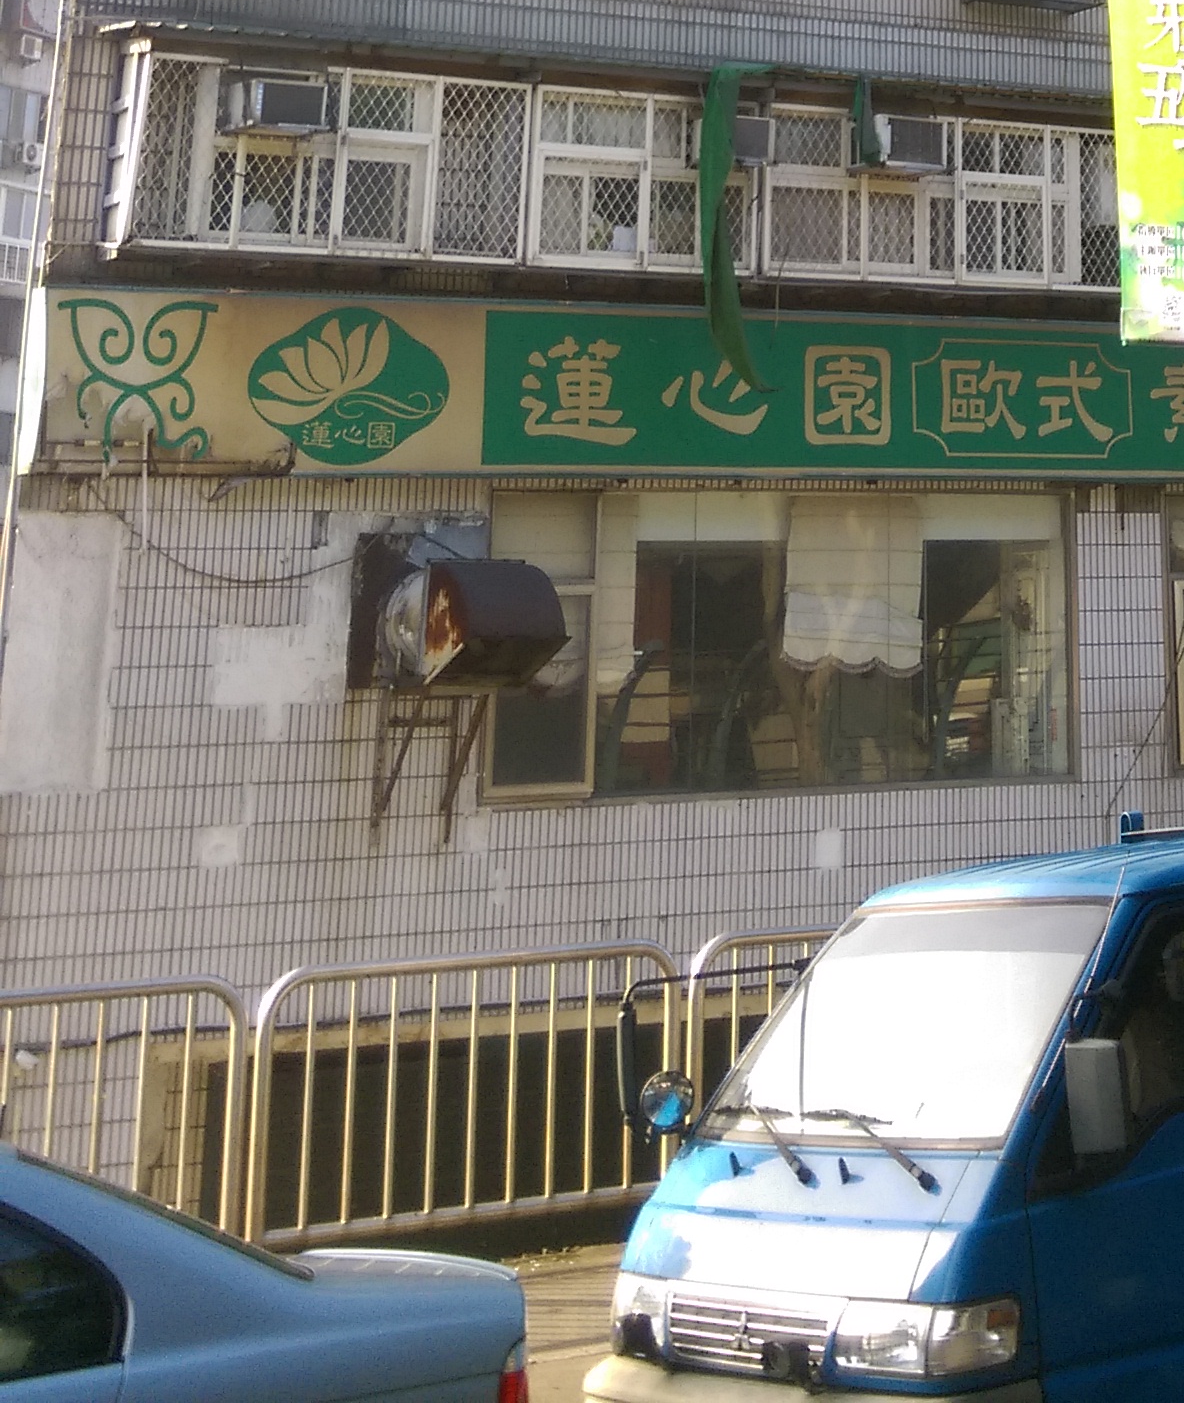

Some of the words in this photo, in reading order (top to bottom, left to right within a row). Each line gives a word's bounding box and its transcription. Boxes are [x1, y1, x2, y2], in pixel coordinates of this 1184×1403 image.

[520, 335, 891, 446] 蓮心園
[941, 359, 1113, 442] 歐式
[303, 421, 396, 449] 蓮心園
